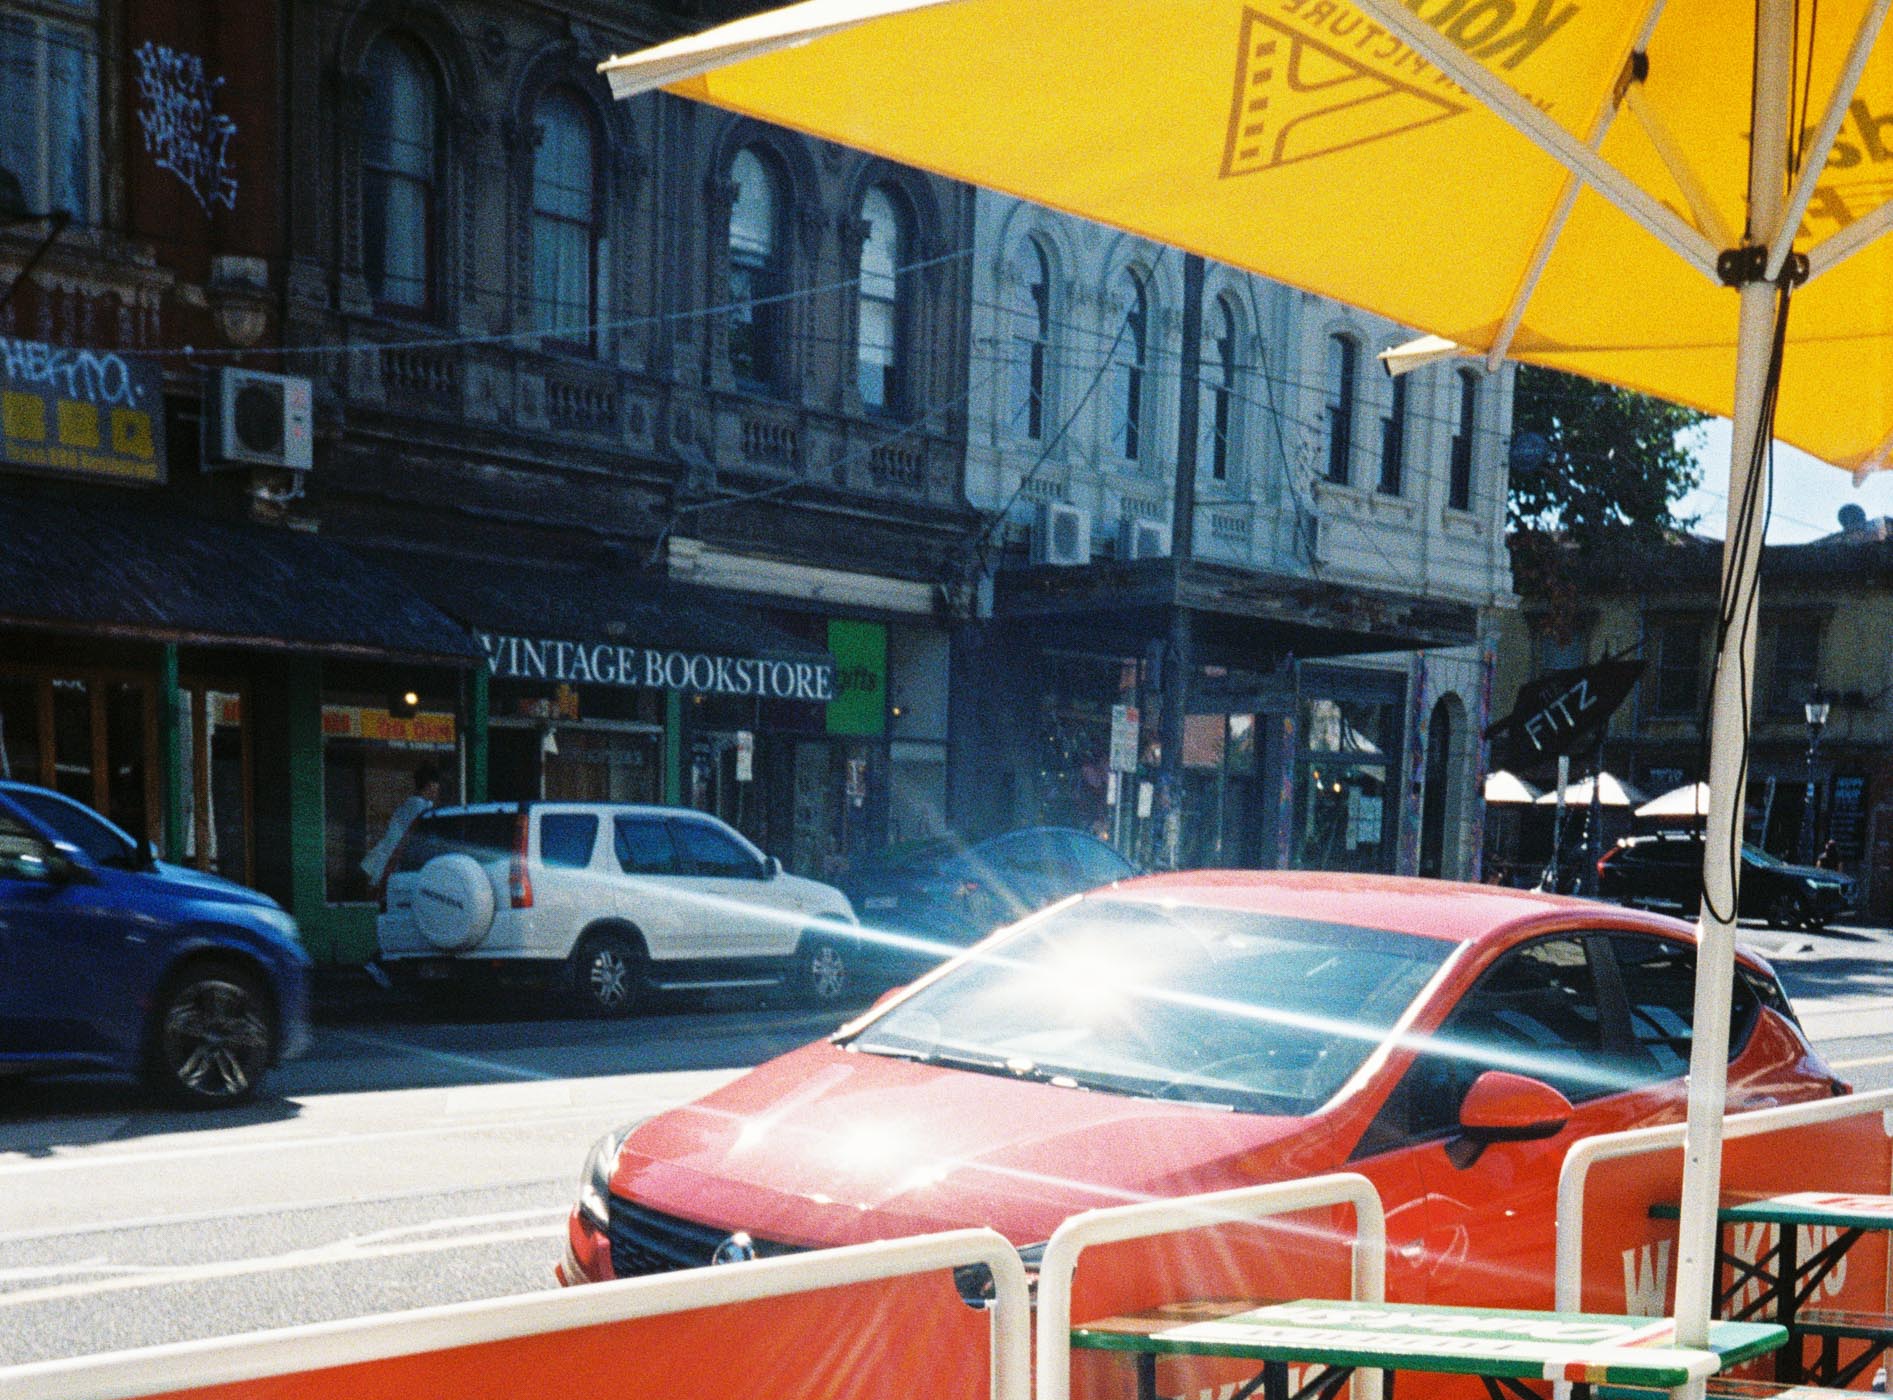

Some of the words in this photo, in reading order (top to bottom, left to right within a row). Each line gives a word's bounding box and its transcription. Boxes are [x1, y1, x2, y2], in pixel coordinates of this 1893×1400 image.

[482, 632, 637, 685] VINTAGE
[645, 649, 833, 700] BOOKSTORE
[1525, 679, 1598, 751] FITZ
